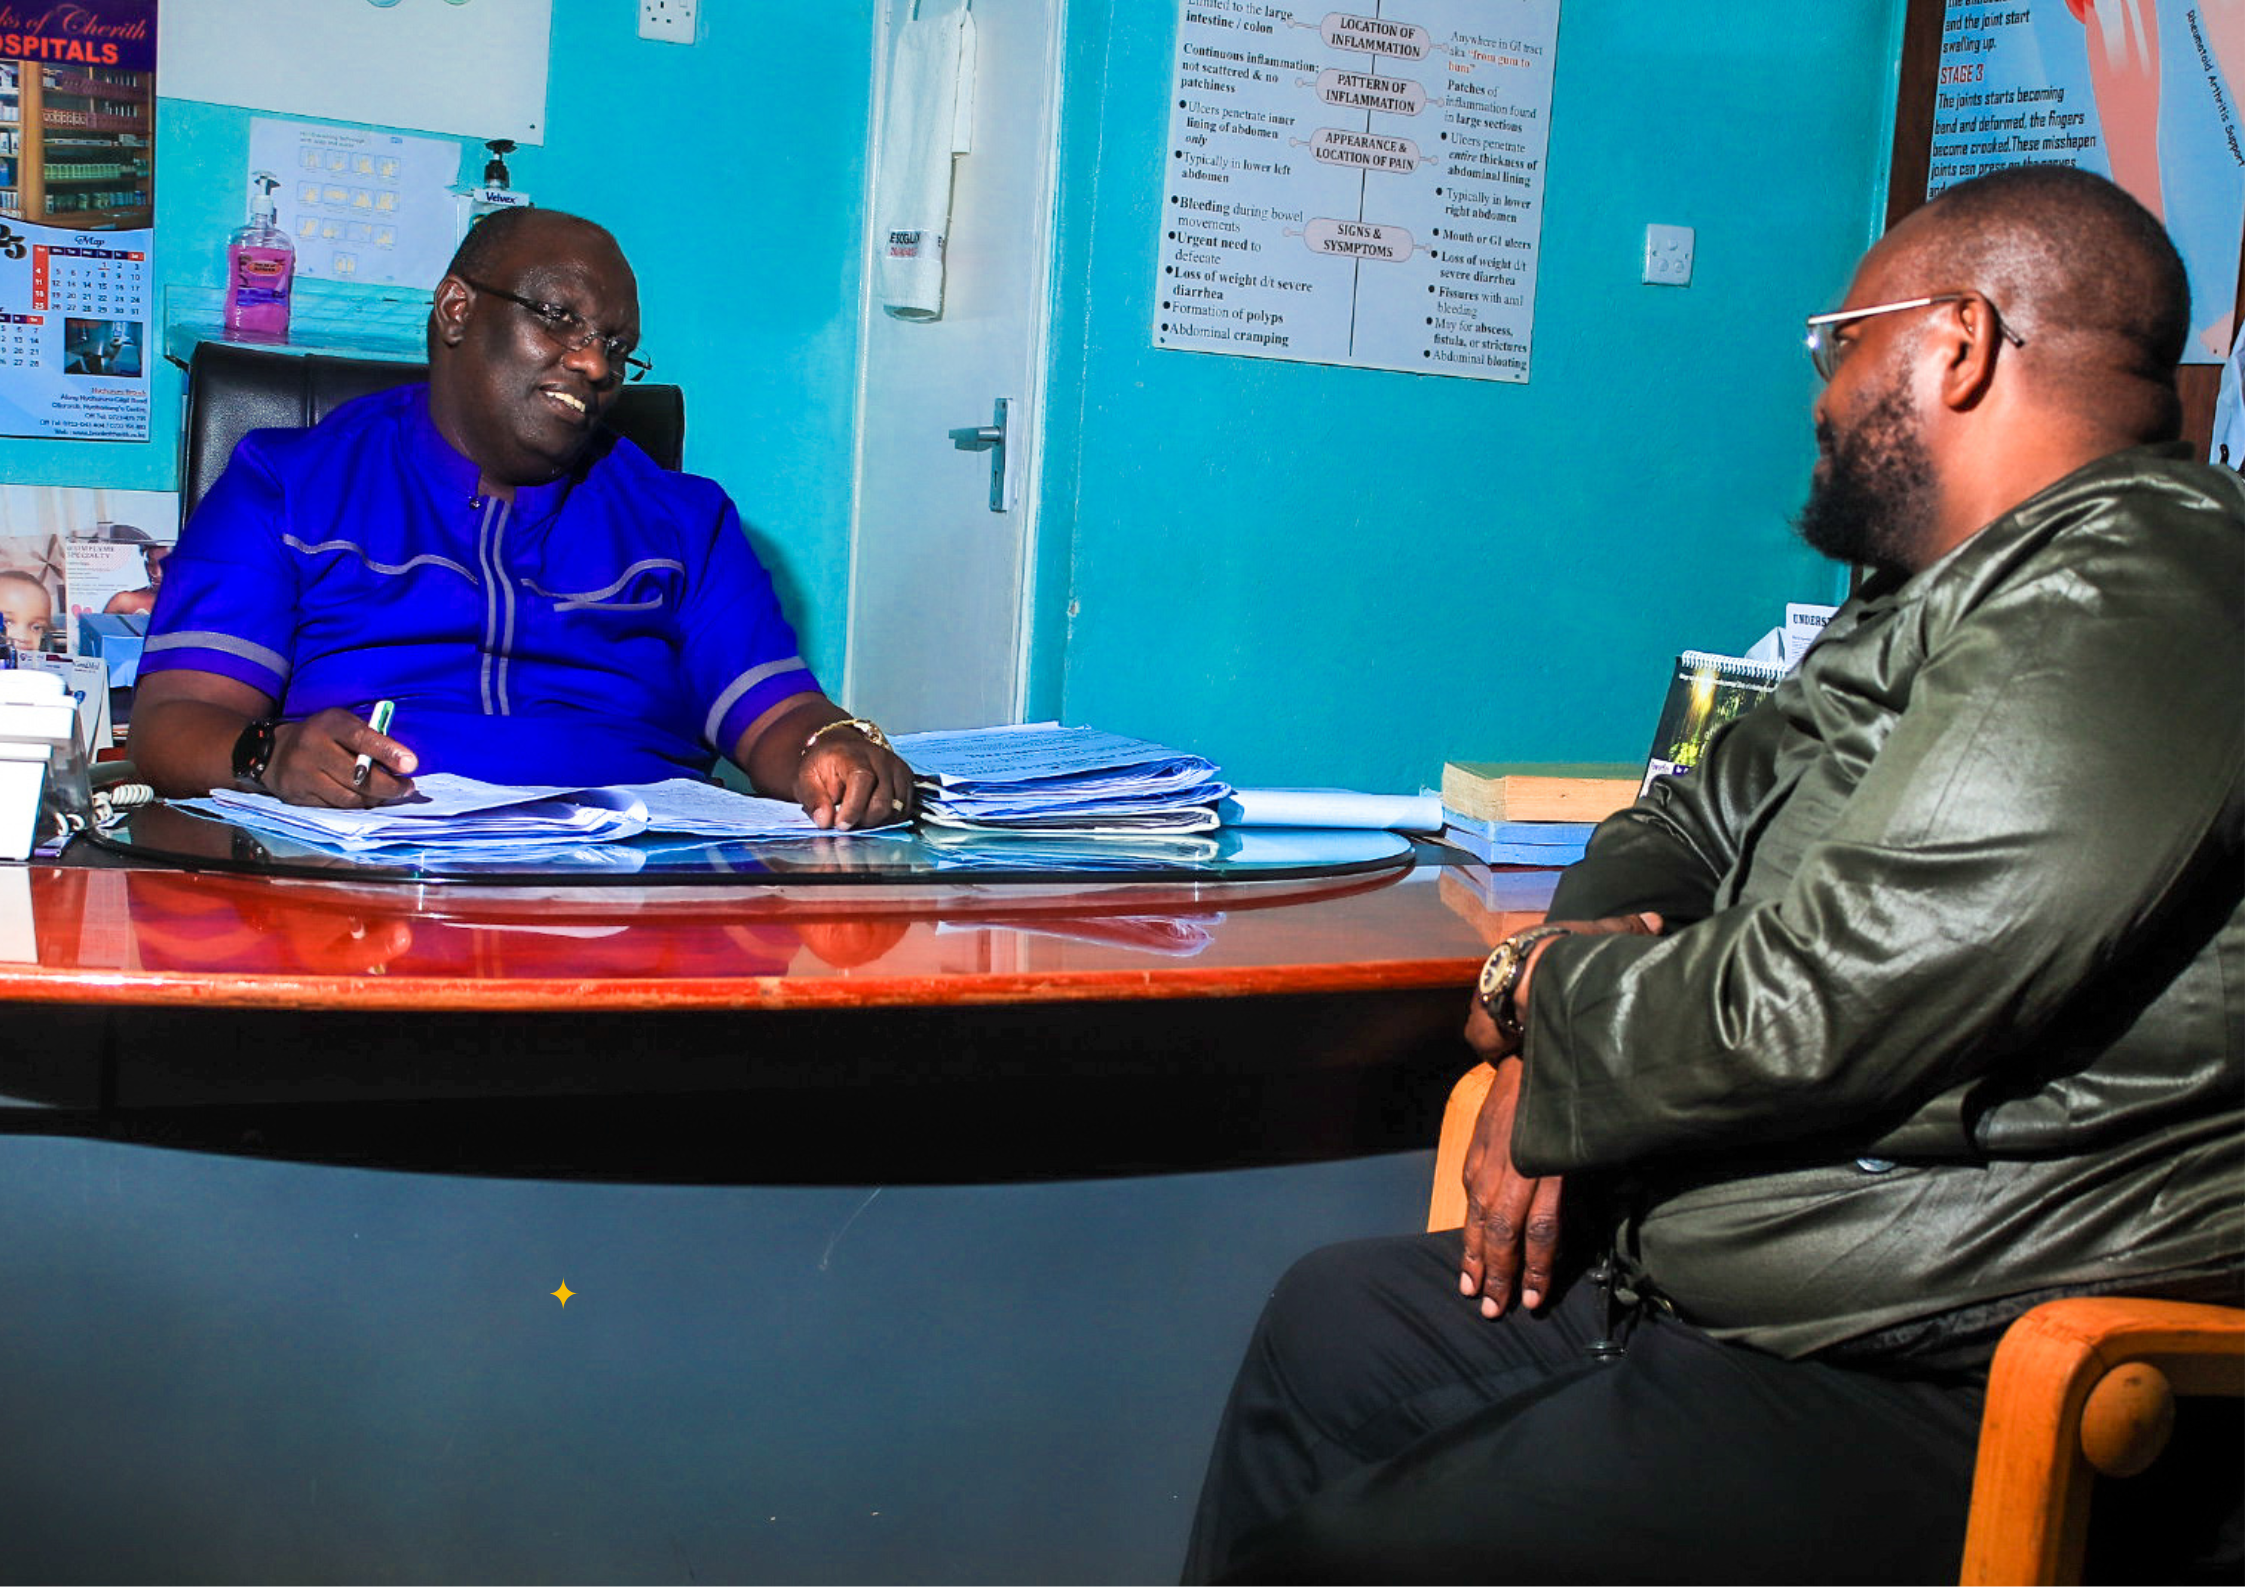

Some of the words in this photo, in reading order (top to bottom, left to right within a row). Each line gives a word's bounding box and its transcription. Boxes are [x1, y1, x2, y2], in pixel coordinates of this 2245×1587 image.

[26, 10, 53, 35] of
[57, 4, 146, 40] Cherith
[1186, 10, 1234, 28] intestine
[1243, 21, 1273, 34] colon
[1232, 2, 1243, 12] to
[1246, 3, 1263, 15] the
[1265, 6, 1293, 21] large
[1945, 15, 1962, 32] and
[1965, 13, 1980, 30] the
[1981, 12, 2003, 31] joint
[2005, 9, 2030, 25] start
[1340, 17, 1397, 36] LOCATION
[1400, 27, 1415, 39] OF
[0, 33, 119, 65] SPITALS
[1183, 42, 1243, 61] Continuous
[1331, 33, 1420, 57] INFLAMMATION
[1450, 31, 1497, 48] Anywhere
[1499, 38, 1507, 49] in
[1510, 40, 1521, 52] GI
[1523, 43, 1543, 55] tract
[1983, 37, 1997, 52] up.
[1449, 46, 1465, 57] aka
[1498, 56, 1518, 67] gum
[1521, 59, 1530, 68] to
[2187, 9, 2214, 72] Rheumatoid
[2208, 75, 2229, 122] Arthritis
[1182, 62, 1199, 72] not
[1202, 63, 1249, 79] scattered
[1253, 71, 1262, 81] &
[1266, 74, 1278, 83] no
[1940, 65, 1973, 84] STAGE
[1976, 64, 1984, 81] 3
[1180, 78, 1235, 93] patchiness
[1337, 74, 1388, 91] PATTERN
[1392, 83, 1406, 94] OF
[1448, 79, 1485, 95] Patches
[1487, 86, 1500, 97] of
[1326, 89, 1415, 112] INFLAMMATION
[1446, 95, 1507, 115] inflammation
[1510, 105, 1537, 119] found
[1938, 93, 1954, 109] The
[1956, 93, 1982, 111] joints
[1985, 90, 2014, 106] starts
[2017, 86, 2064, 104] becoming
[1188, 101, 1219, 115] Ulcers
[1222, 108, 1266, 122] penetrate
[1268, 113, 1295, 126] inner
[1445, 110, 1454, 123] in
[1456, 113, 1481, 129] large
[1484, 119, 1522, 132] sections
[1960, 115, 1977, 133] and
[1979, 112, 2027, 131] deformed,
[2030, 112, 2045, 127] the
[2048, 110, 2085, 129] fingers
[1187, 117, 1216, 132] lining
[1219, 122, 1230, 132] of
[1232, 124, 1278, 139] abdomen
[1185, 133, 1207, 147] only
[1325, 132, 1396, 152] APPEARANCE
[1398, 143, 1407, 153] &
[1451, 132, 1480, 147] Ulcers
[1483, 140, 1526, 153] penetrate
[1932, 141, 1967, 157] become
[2043, 133, 2096, 151] misshapen
[1183, 151, 1228, 170] Typically
[1231, 158, 1240, 169] in
[1243, 160, 1271, 172] lower
[1274, 164, 1291, 175] left
[1316, 147, 1369, 164] LOCATION
[1373, 155, 1385, 166] OF
[1389, 158, 1414, 170] PAIN
[1449, 151, 1478, 162] entire
[1480, 153, 1524, 170] thickness
[1527, 160, 1538, 171] of
[1181, 168, 1229, 183] abdomen
[1448, 165, 1500, 181] abdominal
[1503, 171, 1531, 188] lining
[1930, 163, 1957, 180] joints
[1959, 163, 1976, 176] can
[486, 192, 516, 204] Velvex
[1447, 187, 1489, 206] Typically
[1492, 193, 1501, 205] in
[1504, 196, 1531, 209] lower
[1180, 196, 1230, 216] Bleeding
[1233, 202, 1268, 221] during
[1271, 207, 1303, 222] bowel
[1445, 204, 1470, 218] right
[1472, 208, 1517, 223] abdomen
[1178, 216, 1240, 232] movements
[1337, 223, 1371, 238] SIGNS
[1373, 228, 1381, 239] &
[1177, 231, 1218, 247] Urgent
[1221, 239, 1247, 250] need
[1251, 241, 1261, 252] to
[1323, 239, 1393, 257] SYSMPTOMS
[1443, 229, 1474, 243] Mouth
[1476, 235, 1487, 244] or
[1489, 235, 1502, 246] GI
[1505, 238, 1531, 250] ulcers
[1175, 249, 1221, 264] defecate
[1442, 251, 1464, 263] Loss
[1466, 255, 1477, 265] of
[1479, 257, 1511, 270] weight
[1174, 266, 1200, 279] Loss
[1204, 270, 1217, 281] of
[1219, 272, 1256, 288] weight
[1260, 275, 1274, 288] d/t
[1277, 281, 1312, 292] severe
[1440, 269, 1471, 280] severe
[1473, 271, 1516, 285] diarrhea
[1173, 284, 1223, 300] diarrhea
[1439, 286, 1479, 301] Fissures
[1481, 292, 1502, 304] with
[1504, 295, 1523, 306] anal
[1172, 301, 1229, 319] Formation
[1232, 308, 1245, 319] of
[1246, 310, 1284, 325] polyps
[1438, 301, 1477, 319] bleeding
[1169, 323, 1230, 339] Abdominal
[1233, 332, 1289, 347] cramping
[1435, 318, 1457, 333] May
[1459, 320, 1472, 332] for
[1469, 339, 1480, 348] or
[1482, 339, 1527, 353] strictures
[1433, 350, 1484, 365] Abdominal
[1487, 354, 1527, 371] bloating
